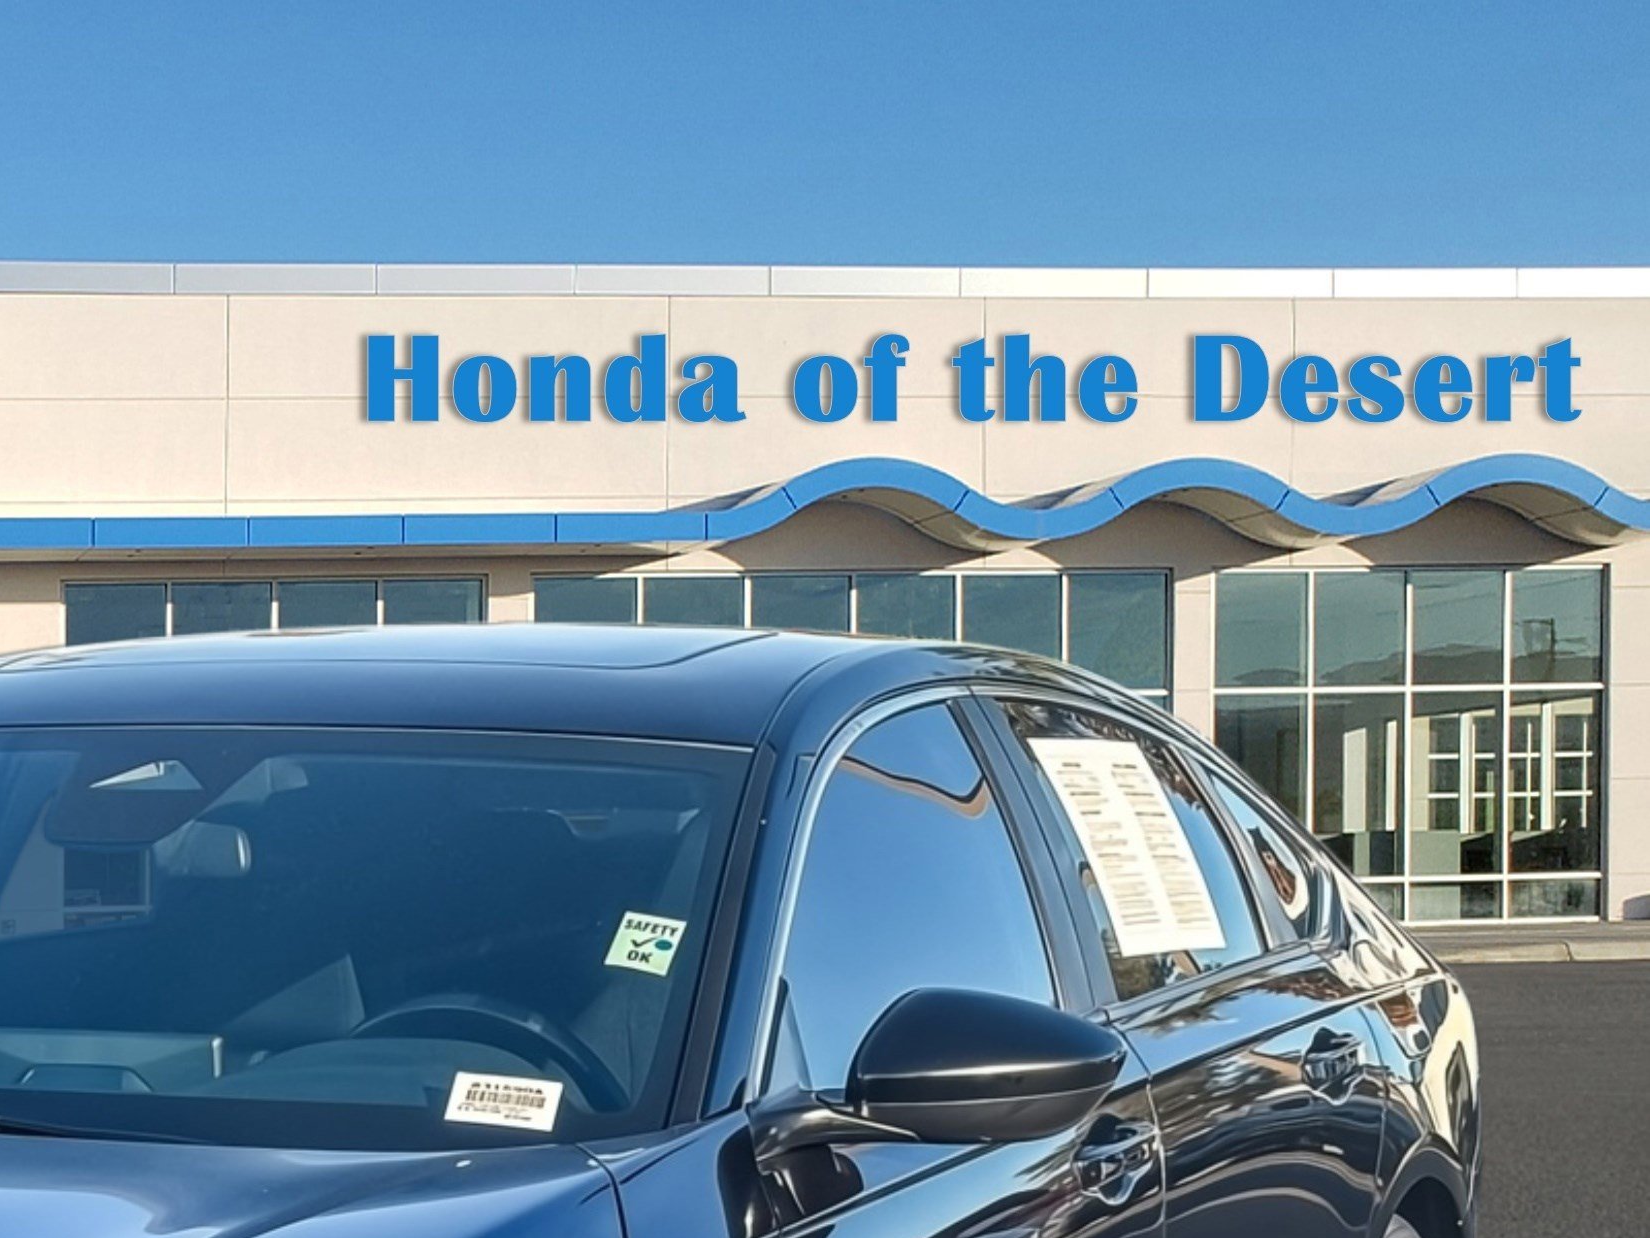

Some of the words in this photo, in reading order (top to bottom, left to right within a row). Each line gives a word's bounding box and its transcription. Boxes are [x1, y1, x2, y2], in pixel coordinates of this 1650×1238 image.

[366, 332, 747, 424] Honda
[793, 332, 911, 424] of
[951, 333, 1138, 423] the
[1193, 334, 1583, 423] Desert
[624, 919, 679, 937] SAFETY
[626, 949, 653, 963] OK
